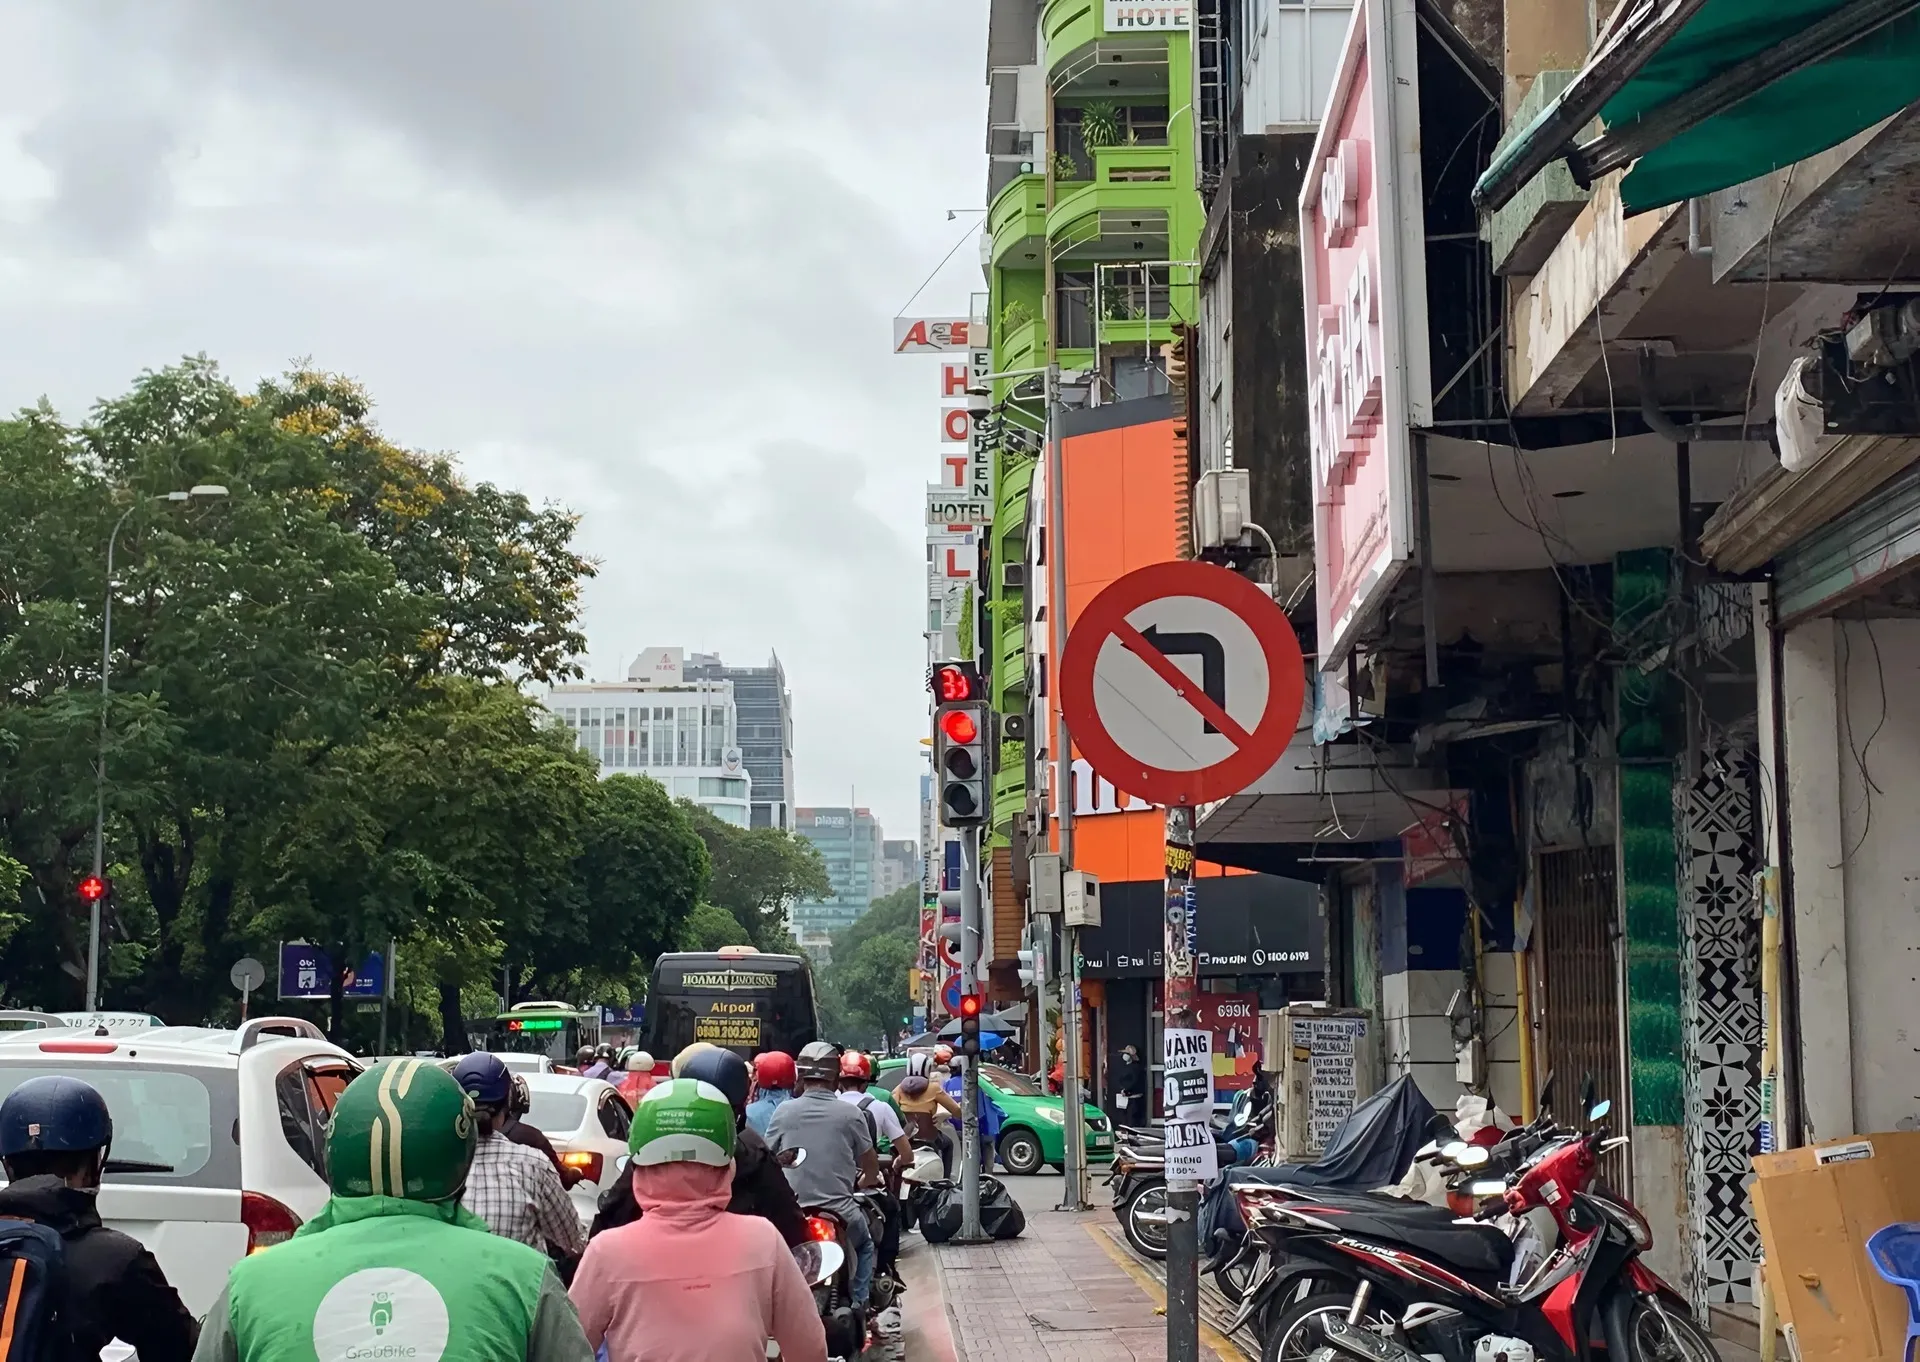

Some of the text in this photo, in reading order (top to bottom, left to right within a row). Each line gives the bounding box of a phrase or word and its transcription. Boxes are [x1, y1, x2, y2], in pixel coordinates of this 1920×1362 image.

[931, 504, 991, 523] HOTEL
[815, 816, 845, 828] plaza
[711, 1002, 754, 1014] Airport
[1217, 1004, 1251, 1017] 699K
[1166, 1033, 1208, 1057] VÀNG
[1190, 1056, 1197, 1067] 2
